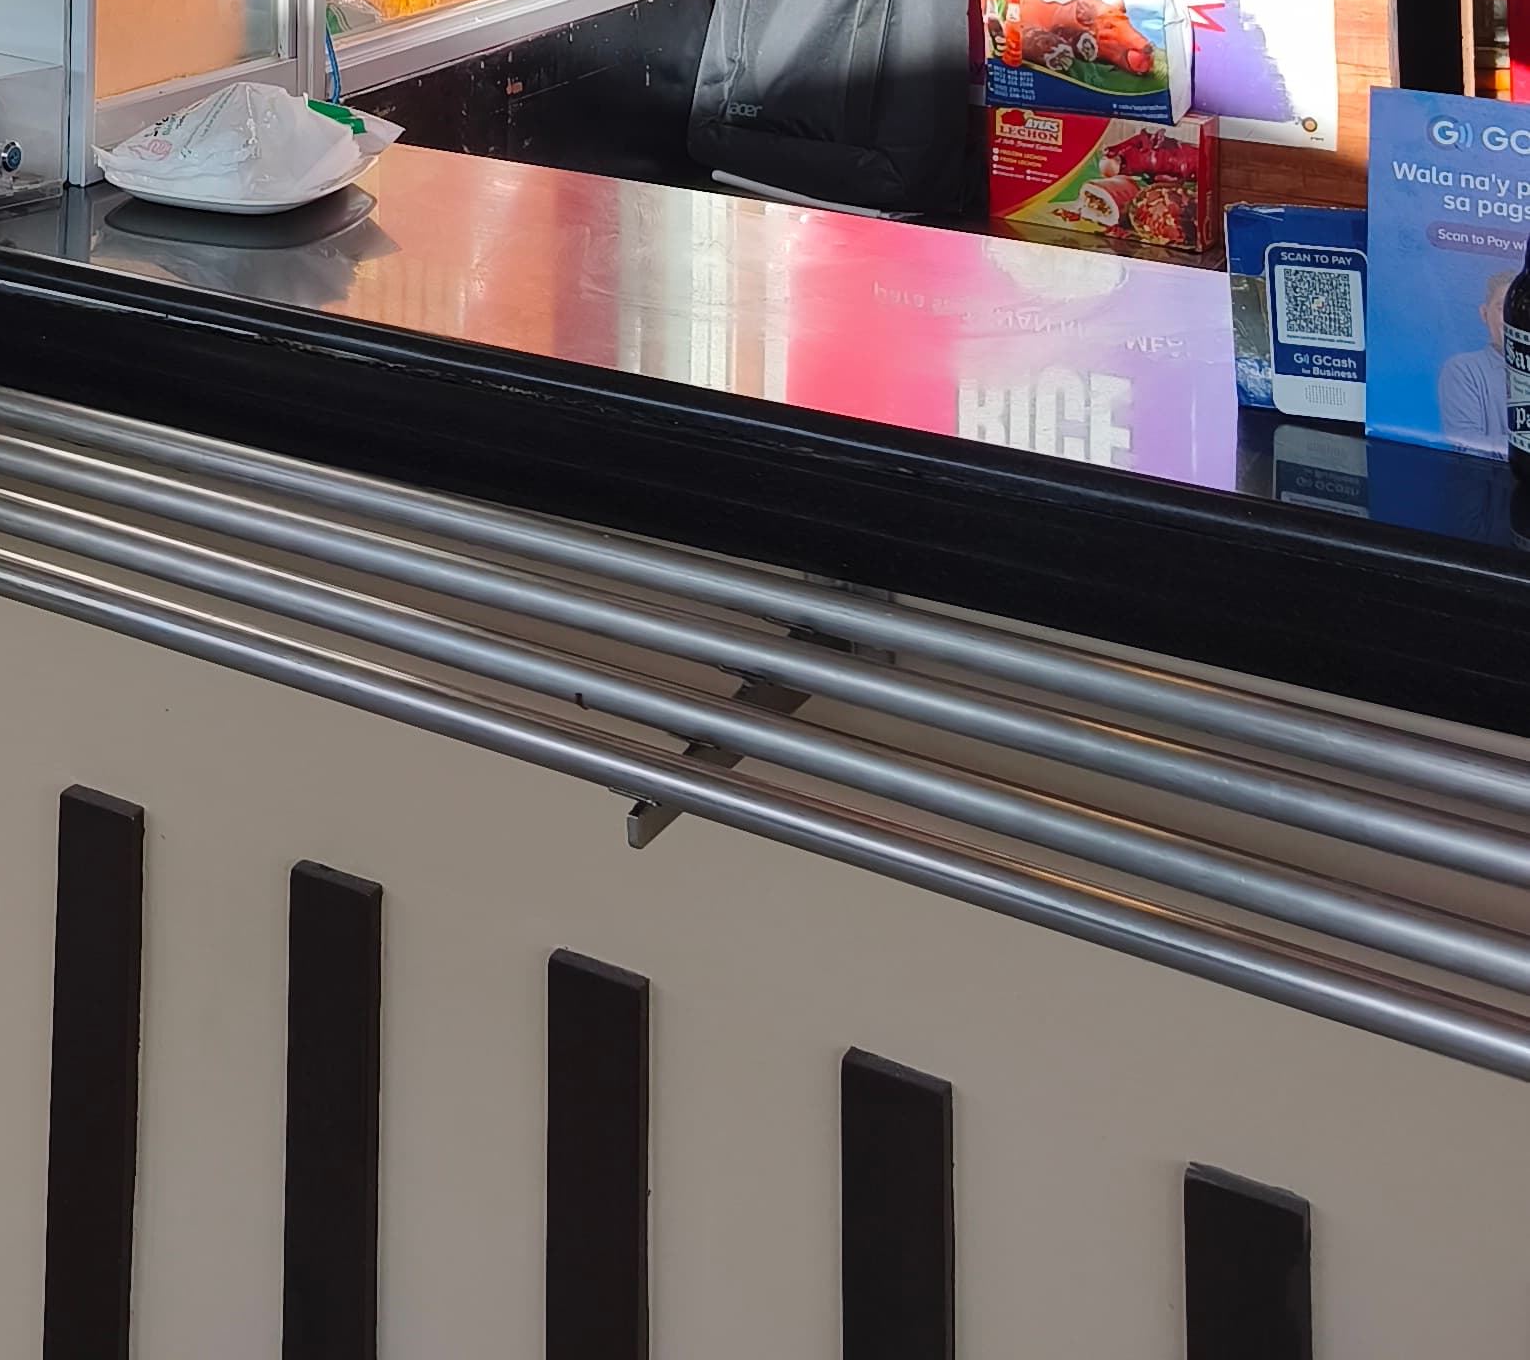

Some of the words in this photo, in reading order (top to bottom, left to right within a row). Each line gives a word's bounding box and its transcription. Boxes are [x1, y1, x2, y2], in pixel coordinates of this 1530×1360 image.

[728, 102, 763, 118] acer
[1000, 125, 1060, 142] LECHON
[1393, 161, 1453, 186] Wala
[1460, 173, 1510, 197] na'y
[1444, 195, 1470, 212] sa
[1437, 229, 1469, 243] Scan
[1472, 234, 1484, 245] to
[1487, 236, 1510, 250] Pay
[1281, 252, 1311, 263] SCAN
[1313, 255, 1329, 263] TO
[1332, 255, 1352, 265] PAY
[1312, 354, 1357, 369] GCash
[1312, 367, 1358, 379] Business
